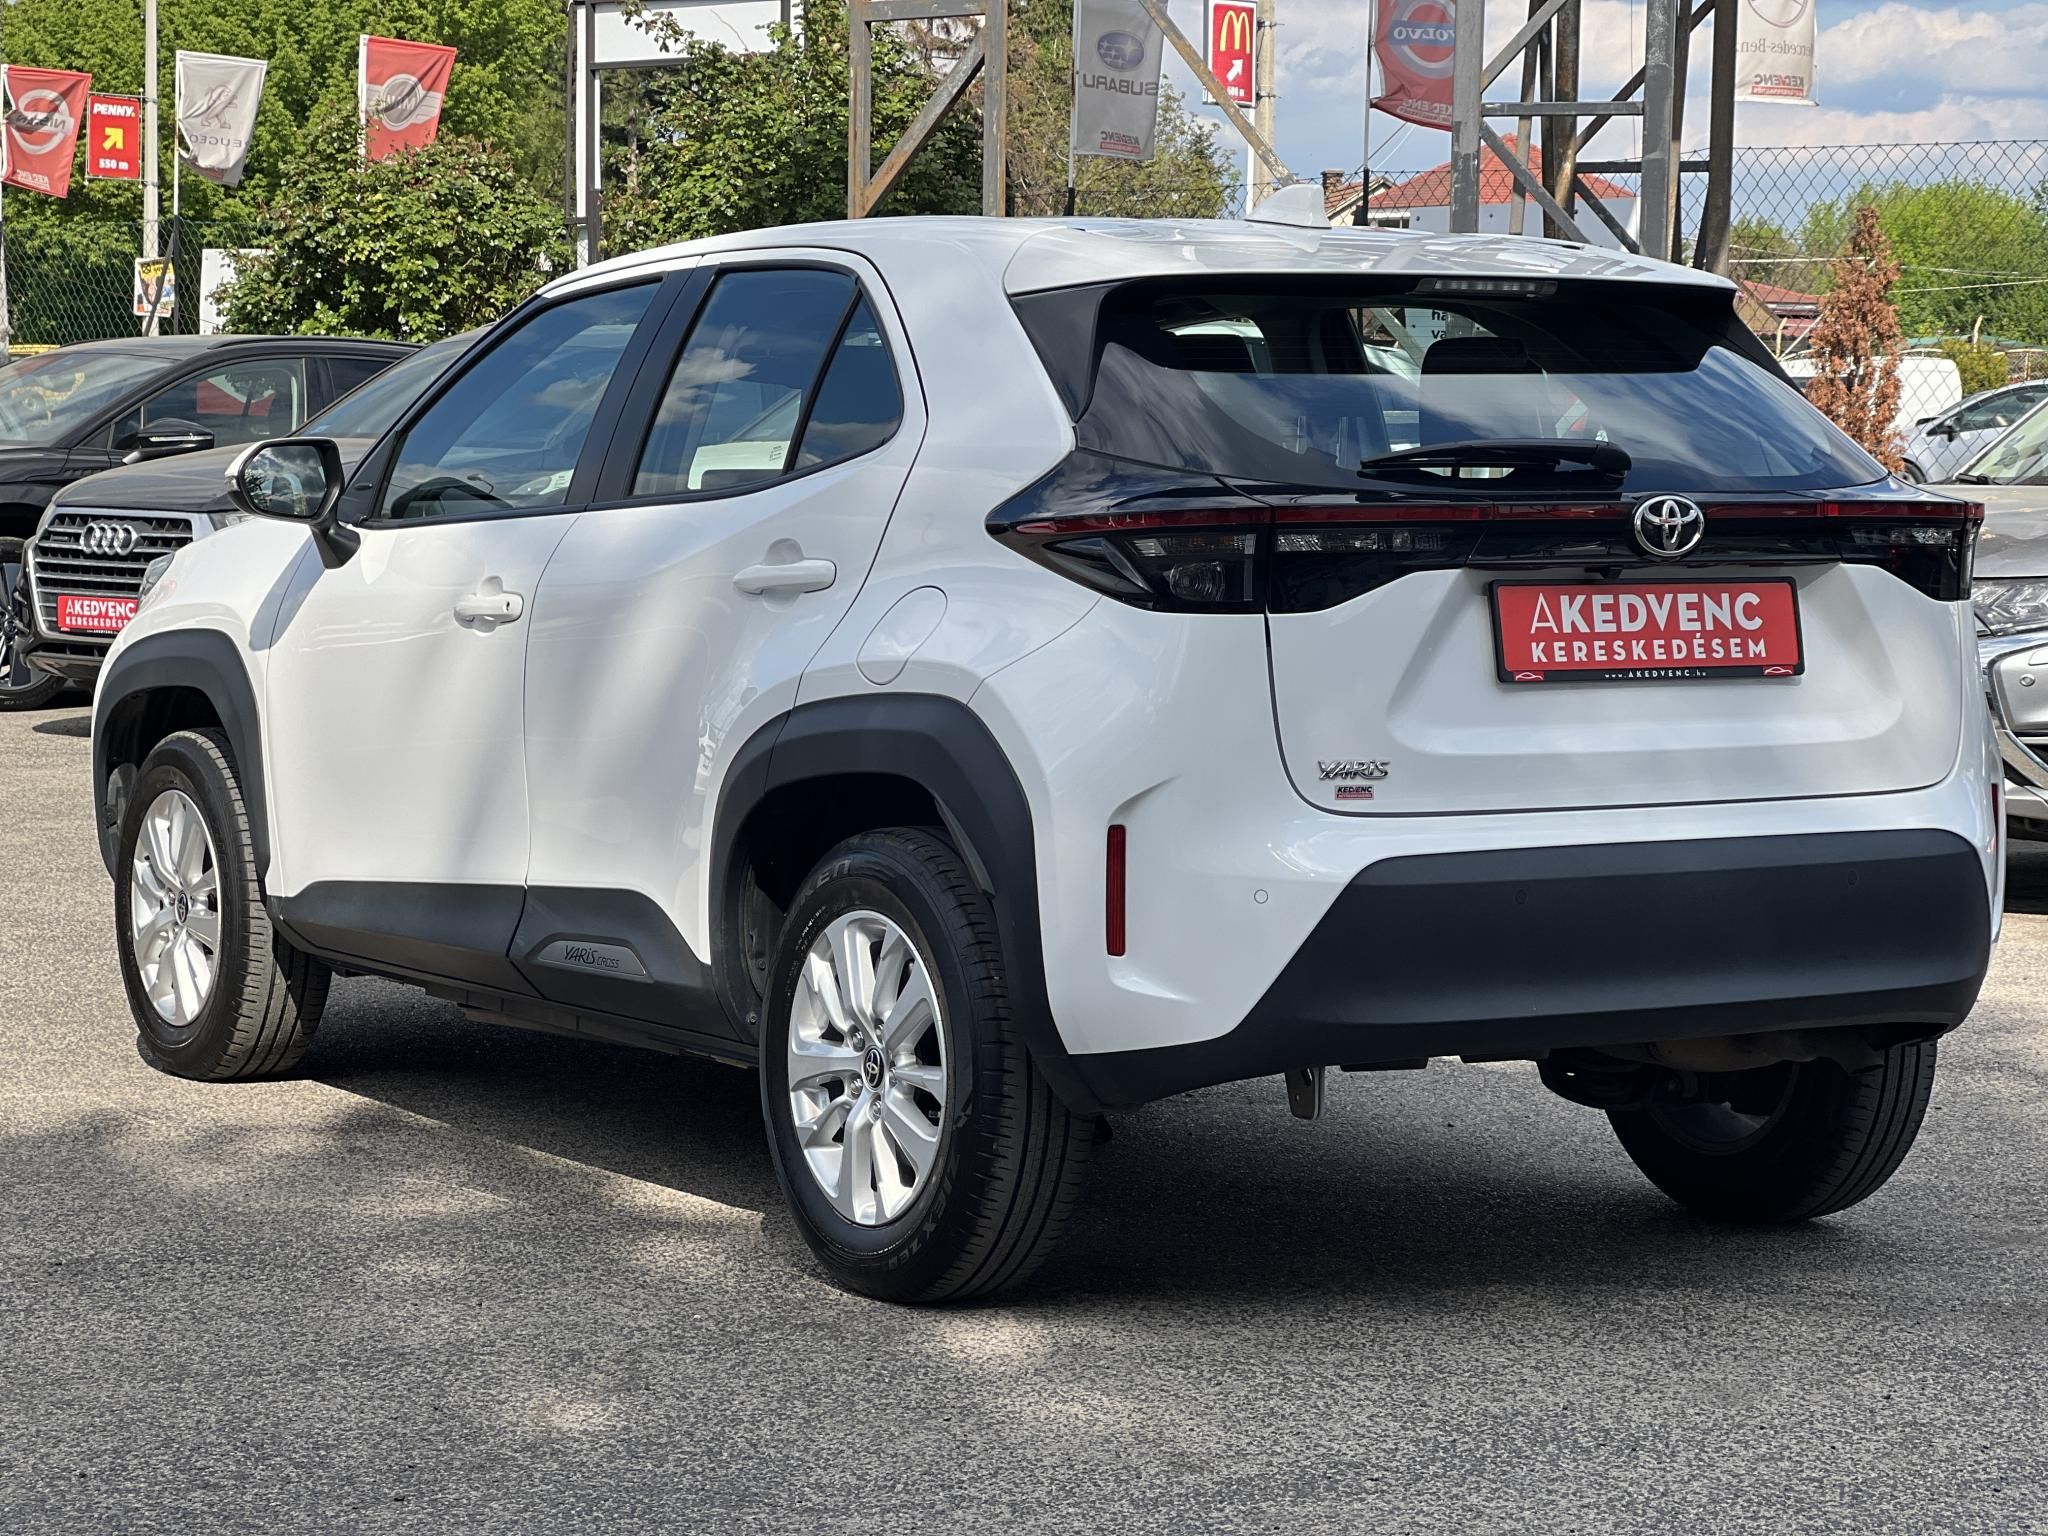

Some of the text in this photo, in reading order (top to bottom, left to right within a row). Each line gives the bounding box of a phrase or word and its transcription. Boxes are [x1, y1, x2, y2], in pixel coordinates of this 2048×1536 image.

[99, 158, 129, 170] 550 m
[65, 599, 135, 618] AKEDVENC
[1530, 592, 1764, 634] AKEDVENC
[65, 616, 129, 628] KERESKEDÉSE
[1531, 633, 1767, 663] KERESKEDÉSEM
[1605, 669, 1706, 678] www.AKEDVENC.hu
[597, 956, 620, 969] CROSS
